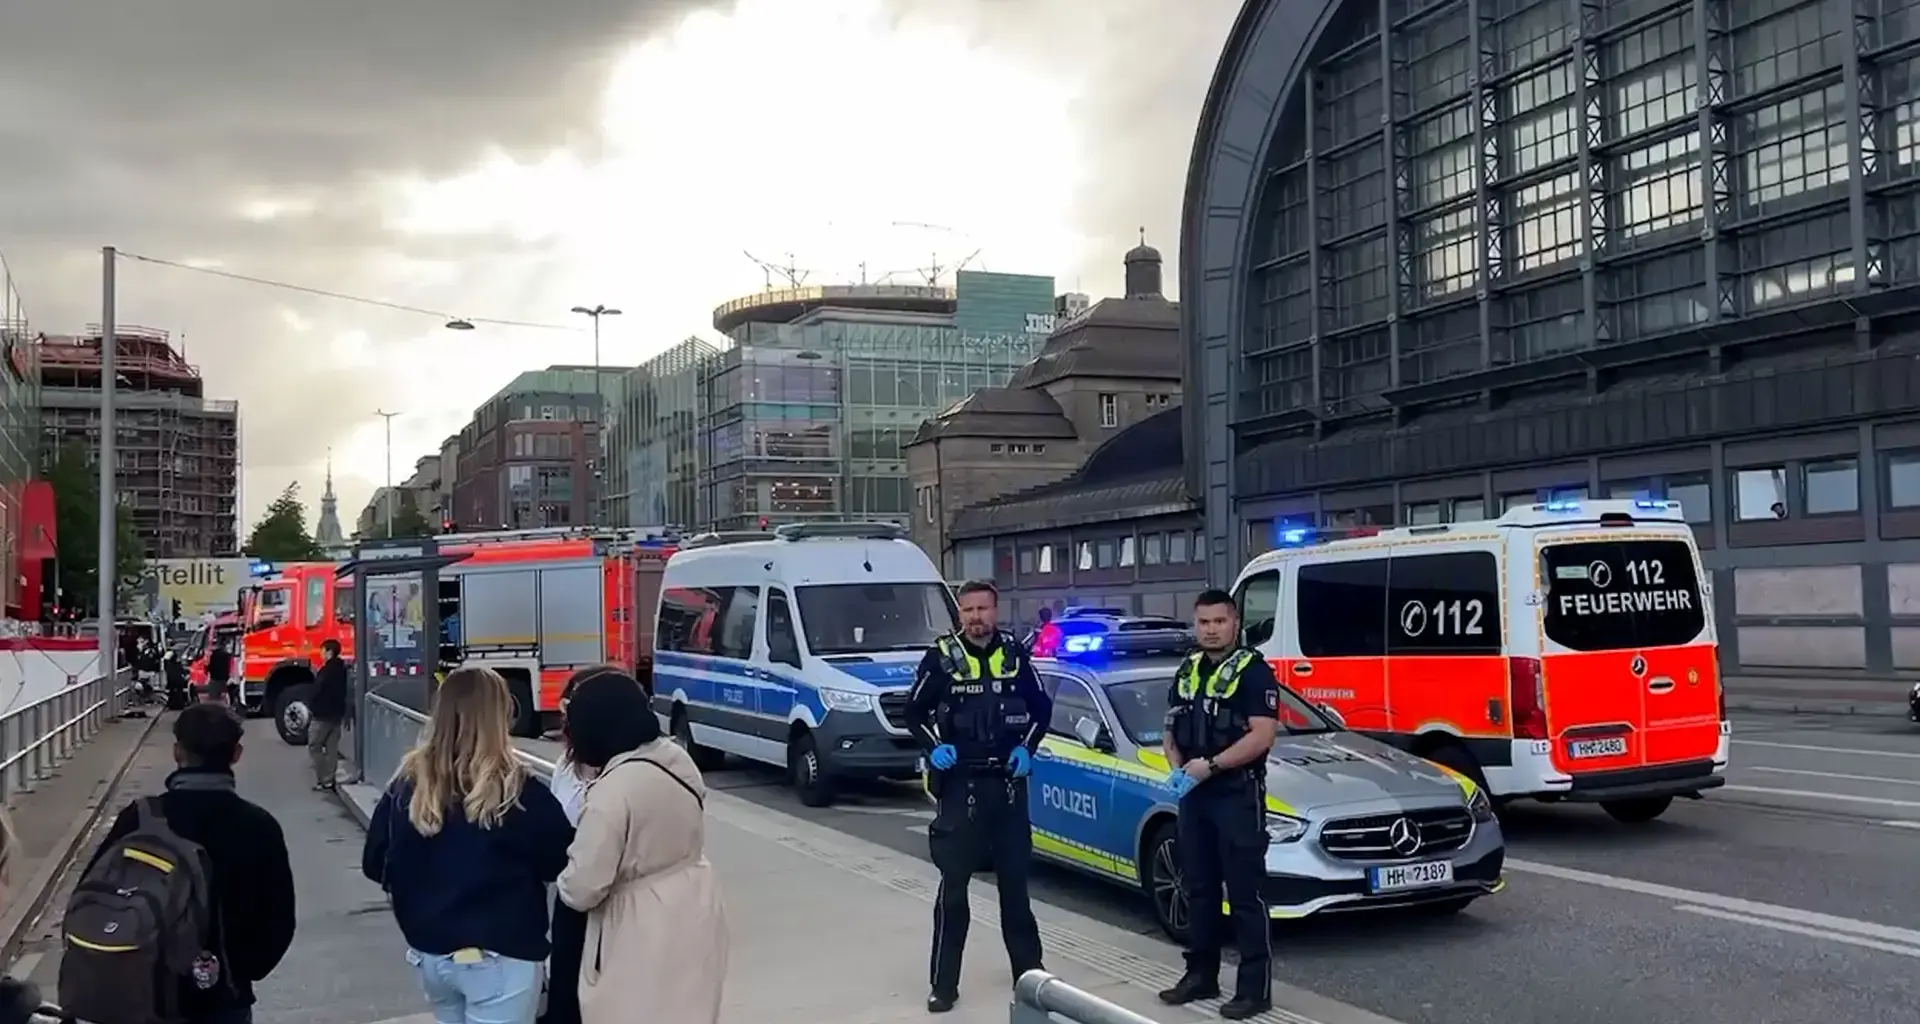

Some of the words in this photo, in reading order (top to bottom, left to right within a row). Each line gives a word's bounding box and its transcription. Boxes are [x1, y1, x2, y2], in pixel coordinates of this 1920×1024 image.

[1626, 559, 1665, 585] 112
[1432, 599, 1483, 635] 112
[1559, 589, 1692, 616] FEUERWEHR
[1042, 783, 1098, 821] POLIZEI
